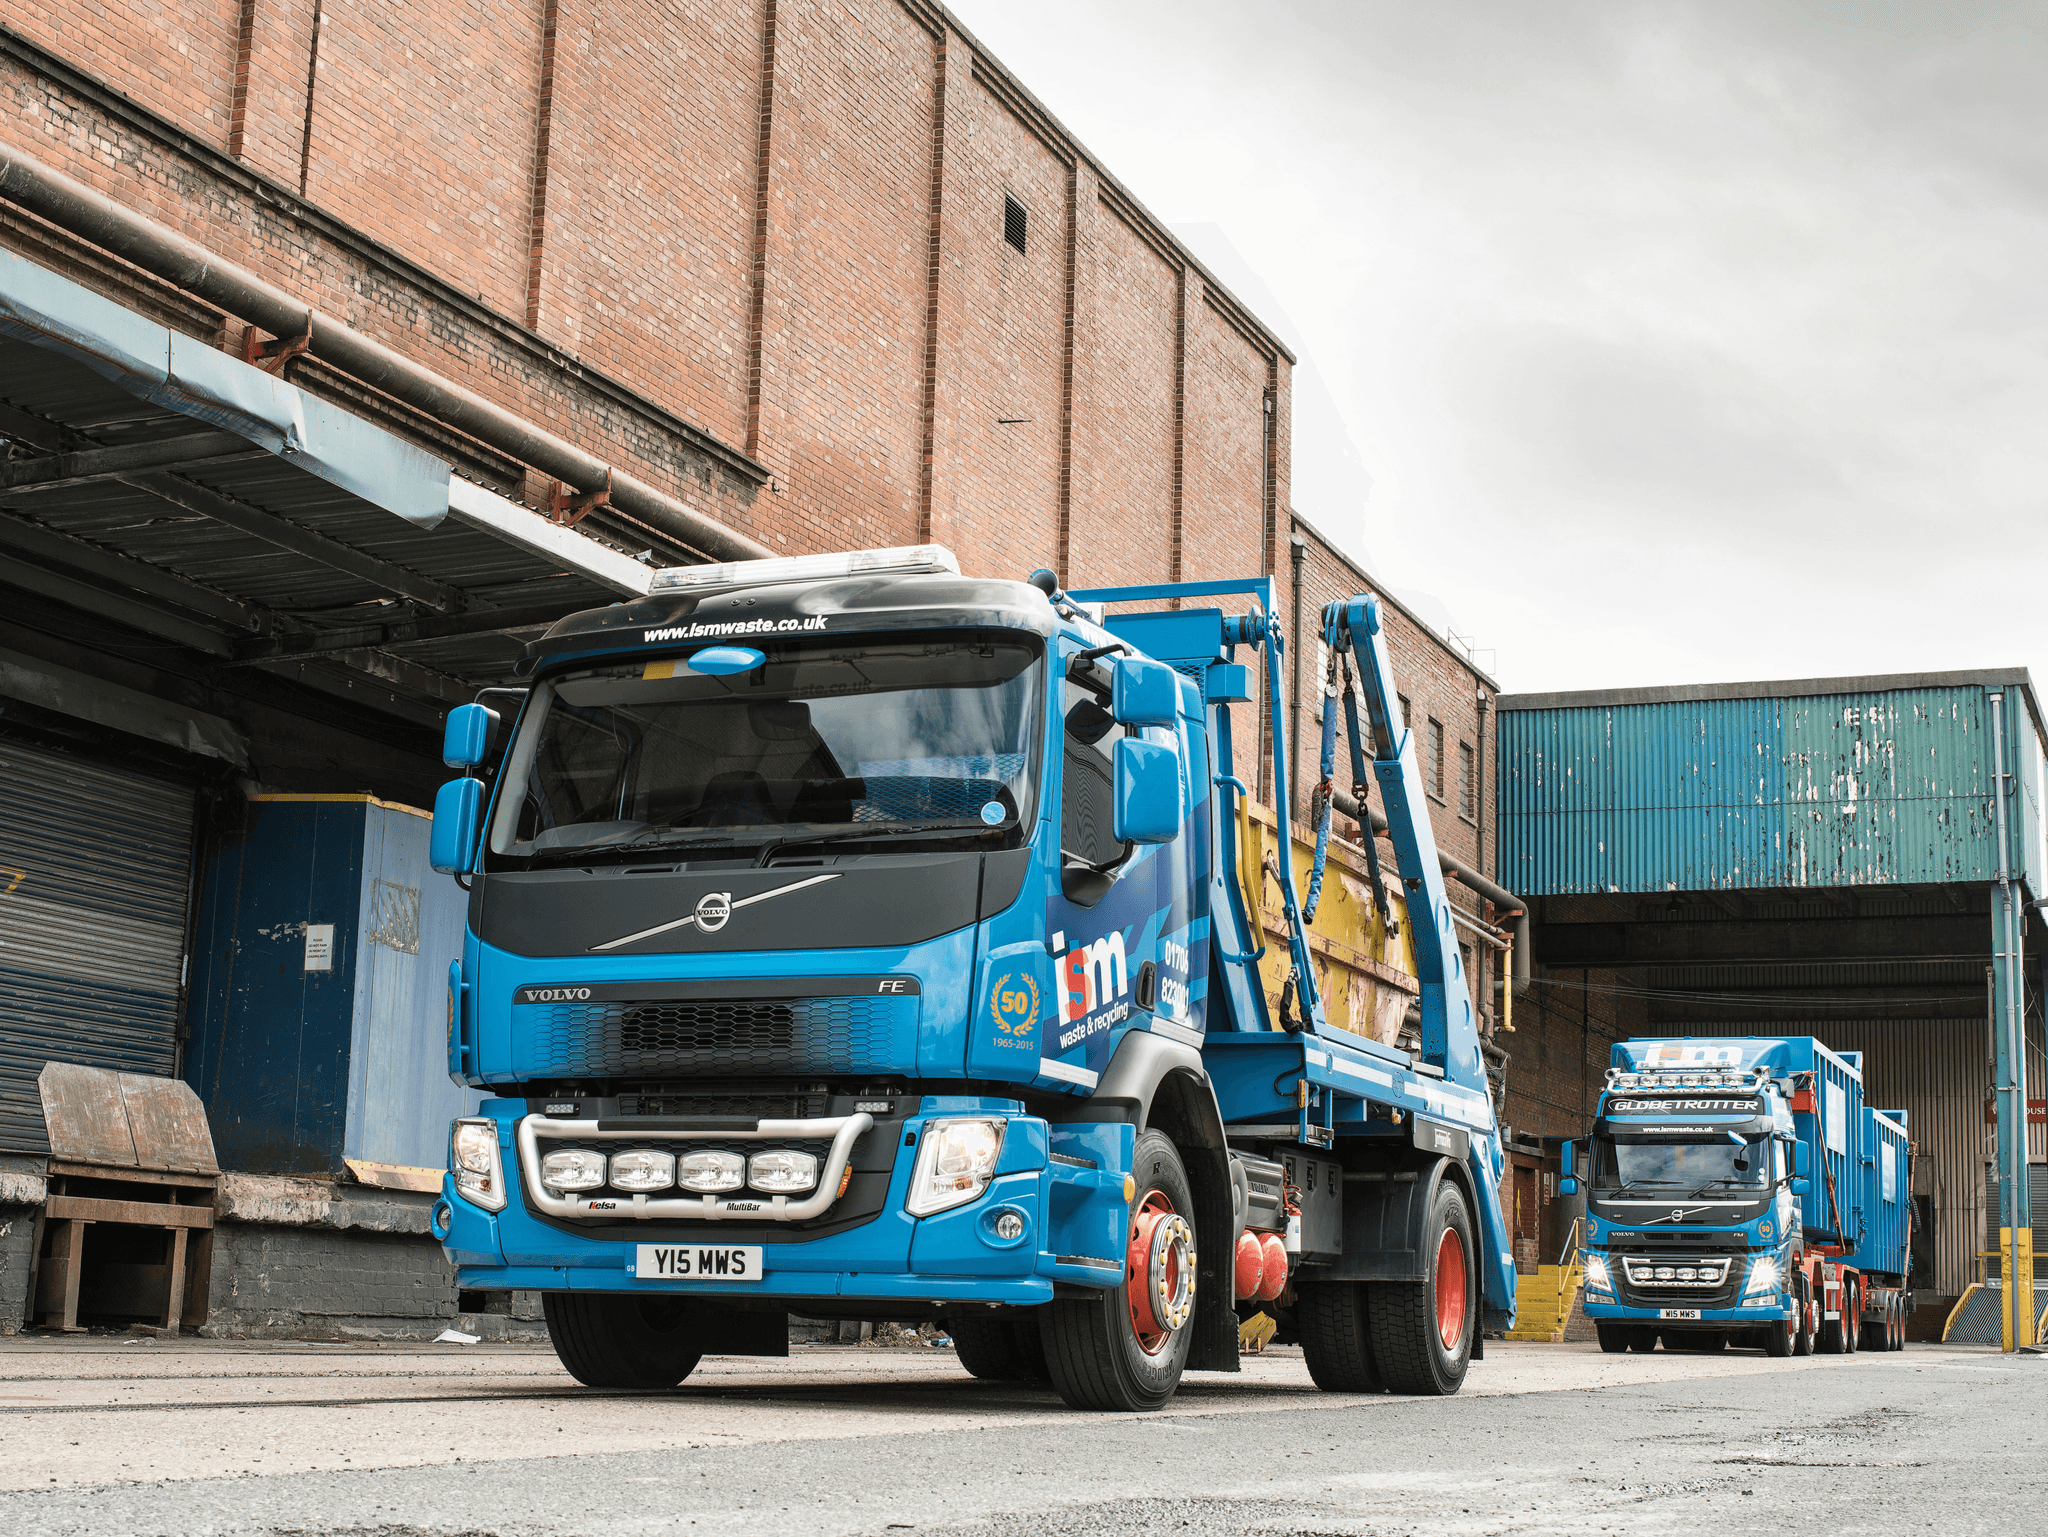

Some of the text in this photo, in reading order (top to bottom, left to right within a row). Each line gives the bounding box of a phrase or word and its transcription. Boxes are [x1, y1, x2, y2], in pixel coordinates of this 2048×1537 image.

[696, 908, 729, 916] VOLVO
[1164, 939, 1189, 975] 01706
[1051, 930, 1128, 1027] ism
[877, 980, 907, 994] FE
[524, 987, 592, 1002] VOLVO
[1001, 990, 1028, 1015] 50
[1059, 1001, 1129, 1049] waste & recycling
[992, 1037, 1034, 1051] 1965-2015
[1614, 1099, 1759, 1112] GLOBETROTTER
[588, 1201, 616, 1210] Kelsa
[726, 1202, 761, 1212] MultiBar
[626, 1264, 636, 1272] GB
[654, 1248, 746, 1275] Y15 MWS
[1665, 1310, 1696, 1318] W15 MWS
